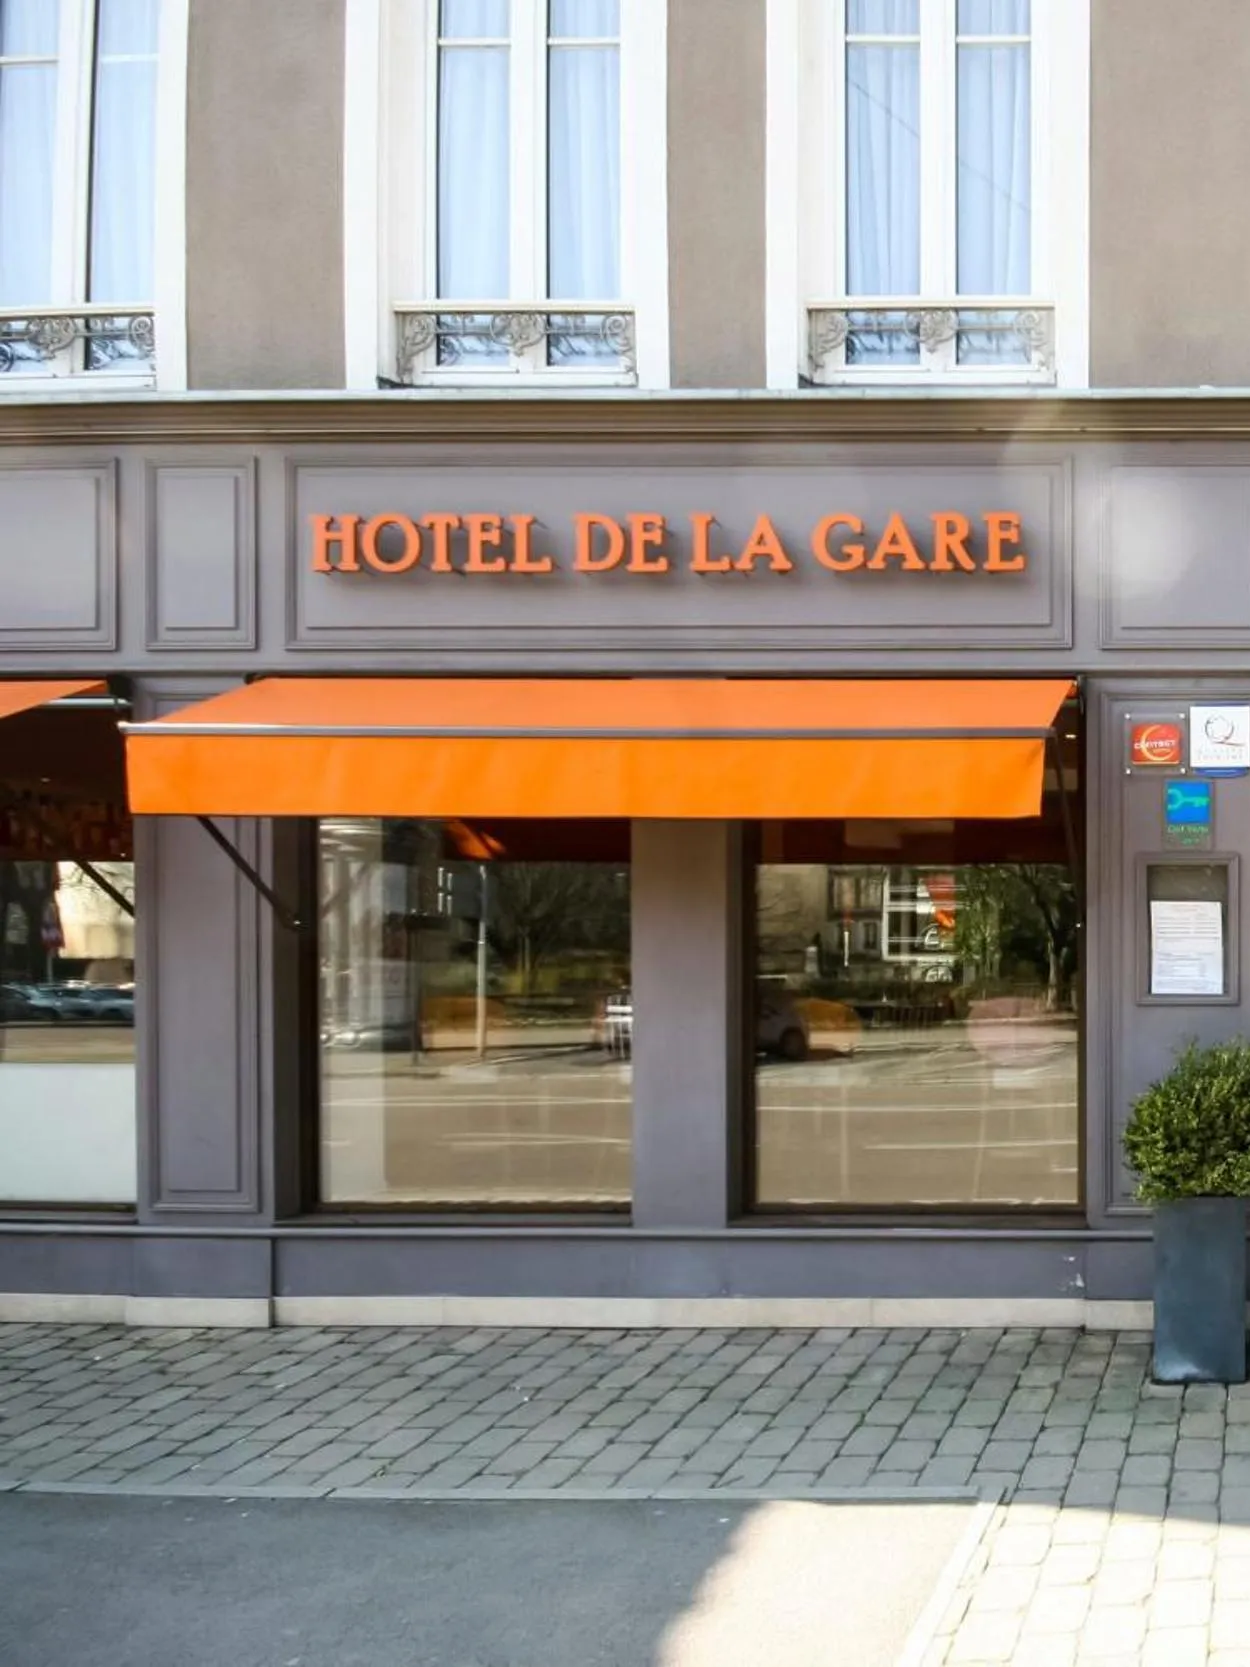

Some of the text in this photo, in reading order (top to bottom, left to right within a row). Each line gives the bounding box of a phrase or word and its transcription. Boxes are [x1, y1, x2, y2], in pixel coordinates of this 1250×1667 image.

[310, 511, 1028, 575] HOTEL DE LA GARE
